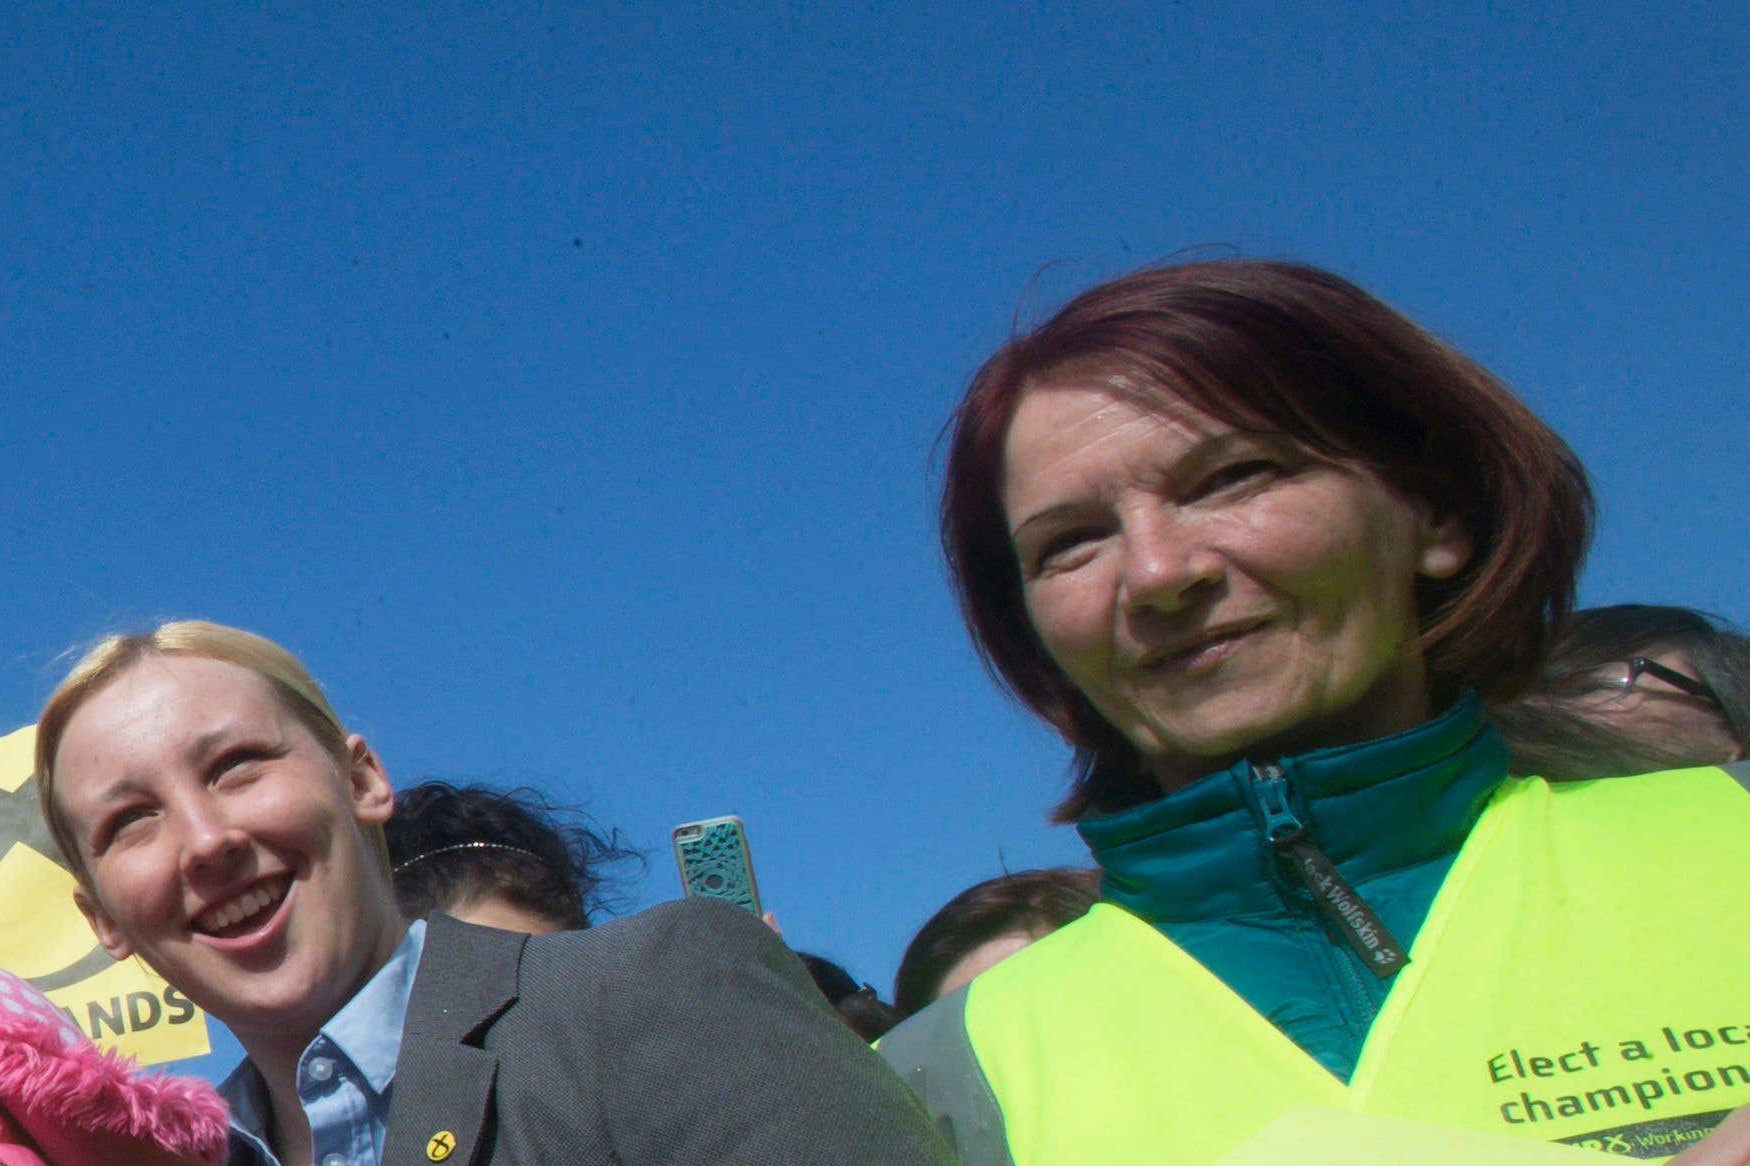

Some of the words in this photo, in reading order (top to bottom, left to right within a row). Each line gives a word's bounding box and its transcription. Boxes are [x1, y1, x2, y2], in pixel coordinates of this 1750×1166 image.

[1326, 885, 1379, 949] Wolfskin
[1486, 1041, 1600, 1084] Elect
[1618, 1040, 1652, 1062] a
[1661, 1024, 1750, 1053] loc
[1499, 1064, 1750, 1125] champion
